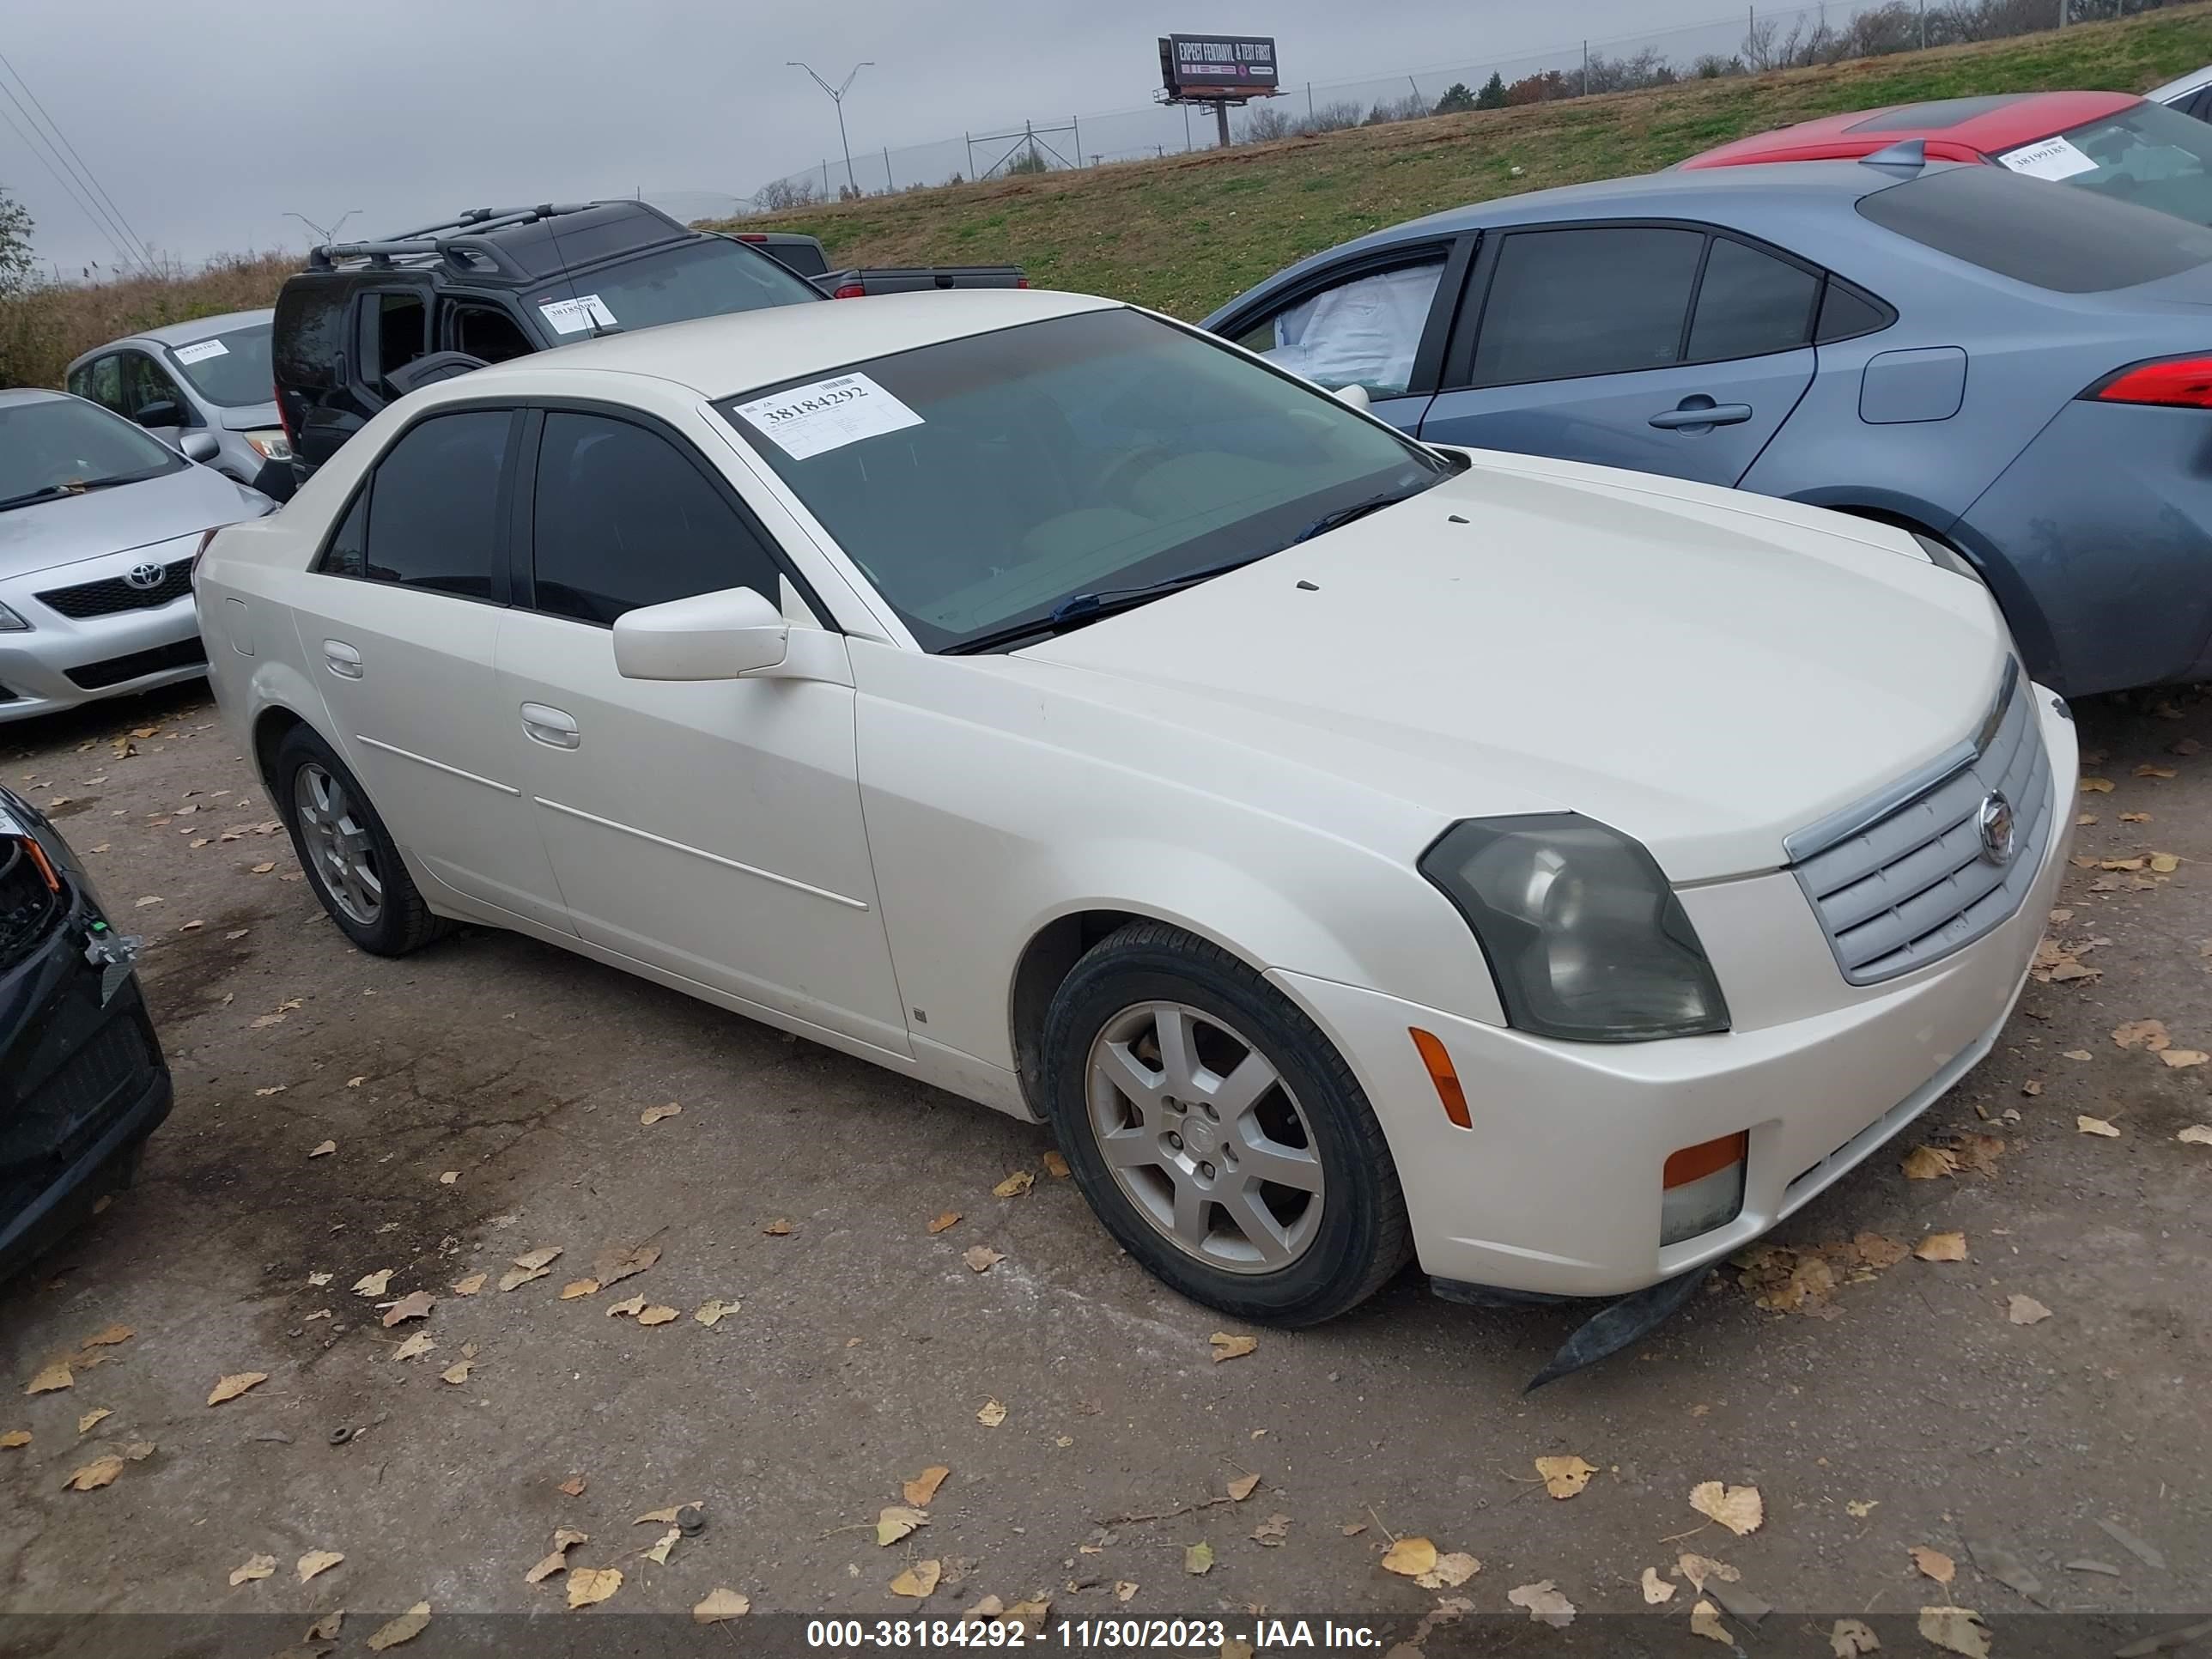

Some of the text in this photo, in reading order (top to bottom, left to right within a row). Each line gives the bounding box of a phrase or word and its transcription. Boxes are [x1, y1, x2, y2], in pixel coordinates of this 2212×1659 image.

[1178, 42, 1271, 62] EXPECT FENTANYL & TEST FIRST
[2014, 145, 2068, 167] 38199185
[763, 386, 869, 425] 38184292
